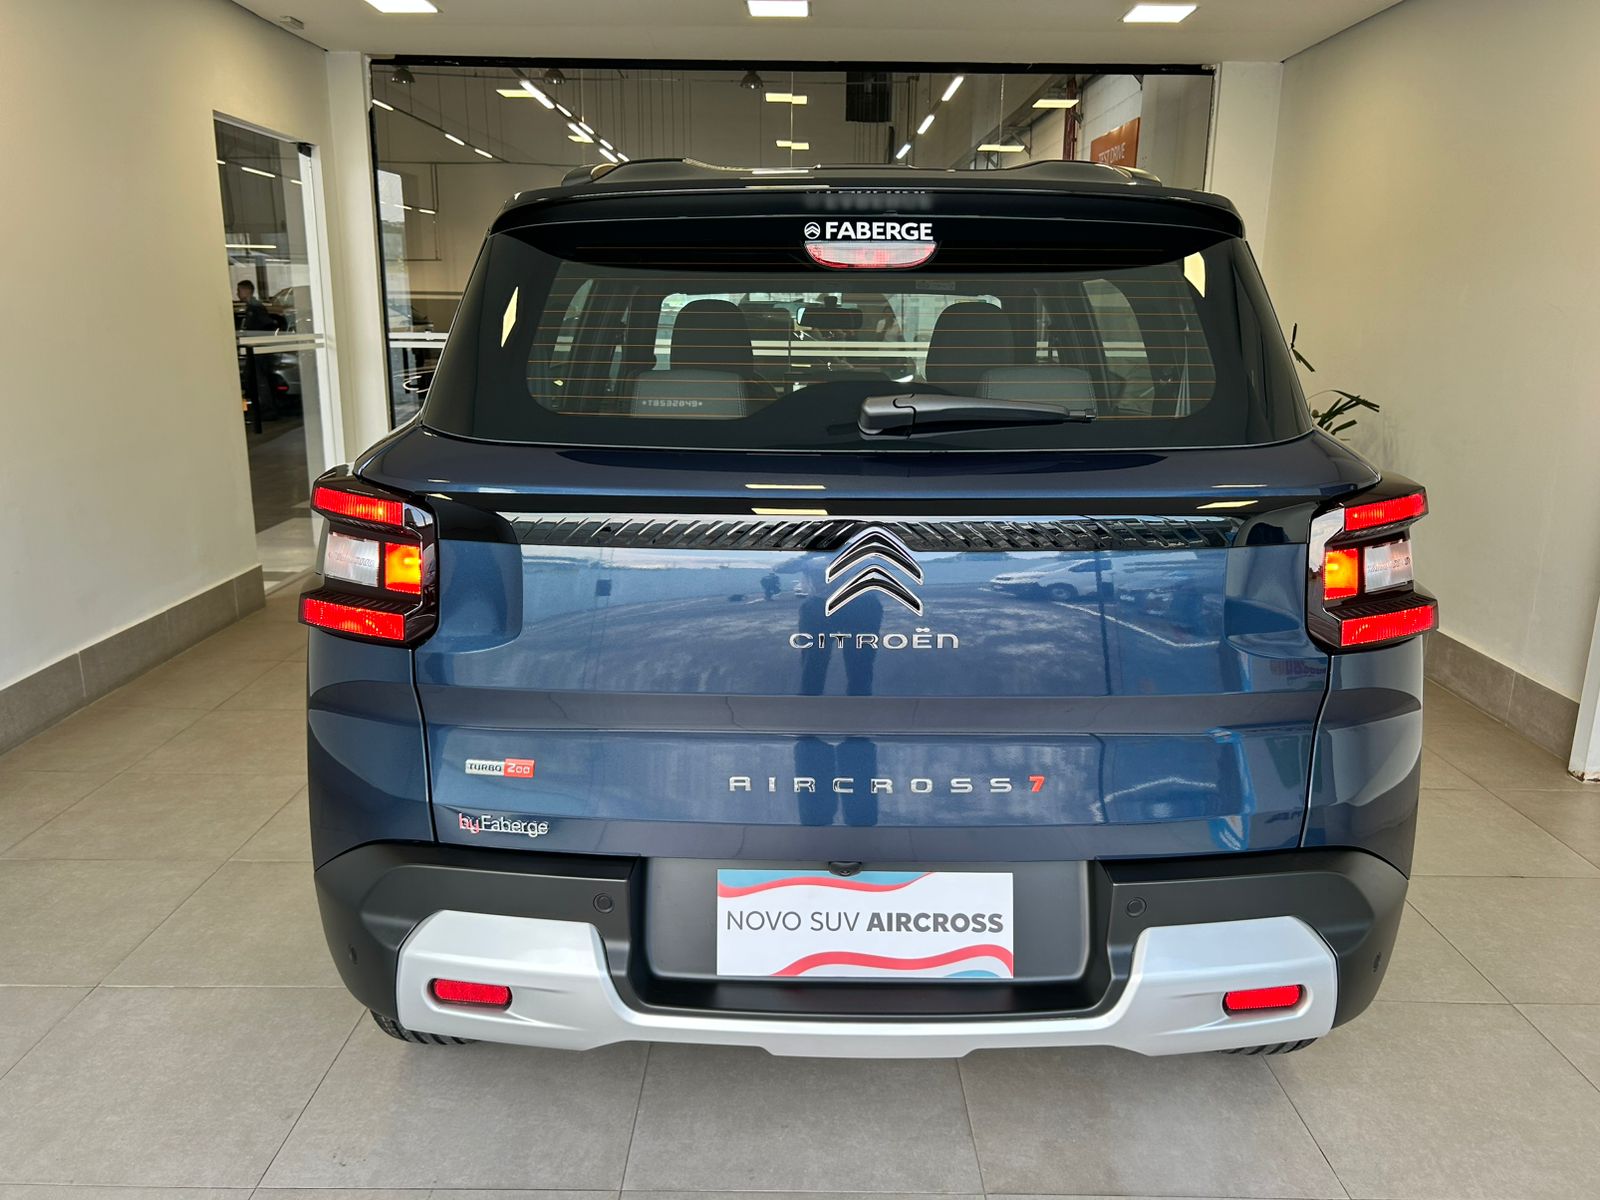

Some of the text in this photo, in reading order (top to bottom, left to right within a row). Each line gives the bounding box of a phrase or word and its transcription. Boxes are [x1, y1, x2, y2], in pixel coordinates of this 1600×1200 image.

[825, 221, 934, 241] FABERGE
[469, 762, 531, 774] TURBO 200
[726, 910, 1004, 933] NOVO SUV AIRCROSS
